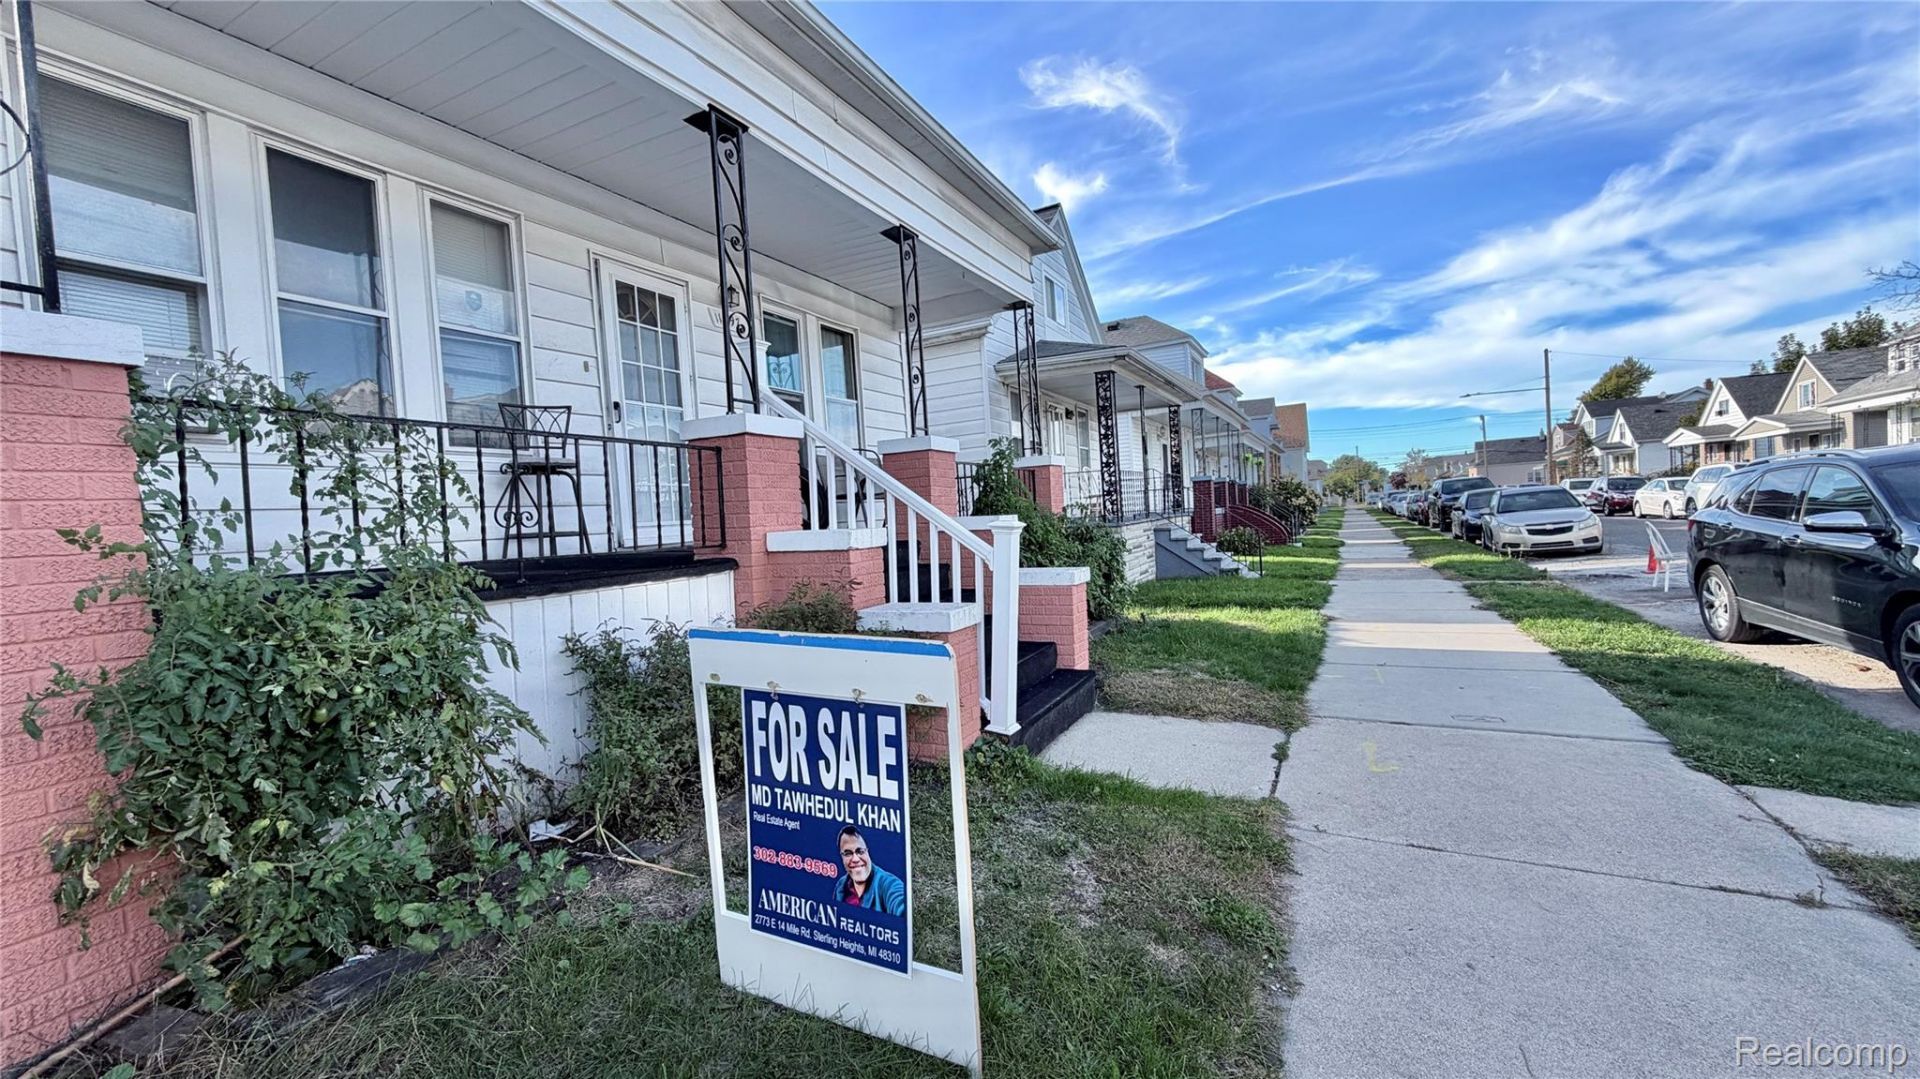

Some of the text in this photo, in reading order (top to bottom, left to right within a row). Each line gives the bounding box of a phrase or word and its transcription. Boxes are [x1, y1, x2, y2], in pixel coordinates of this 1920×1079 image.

[751, 700, 899, 801] FOR SALE
[751, 783, 901, 833] MD TAWHEDUL KHAN
[753, 811, 800, 830] Real Estate Agent
[753, 845, 838, 878] 302-883-9569
[754, 913, 901, 964] 2773 E 14 Mile Rd. Sterling Heights, MI 48310
[758, 888, 899, 945] AMERICAN REALTORS
